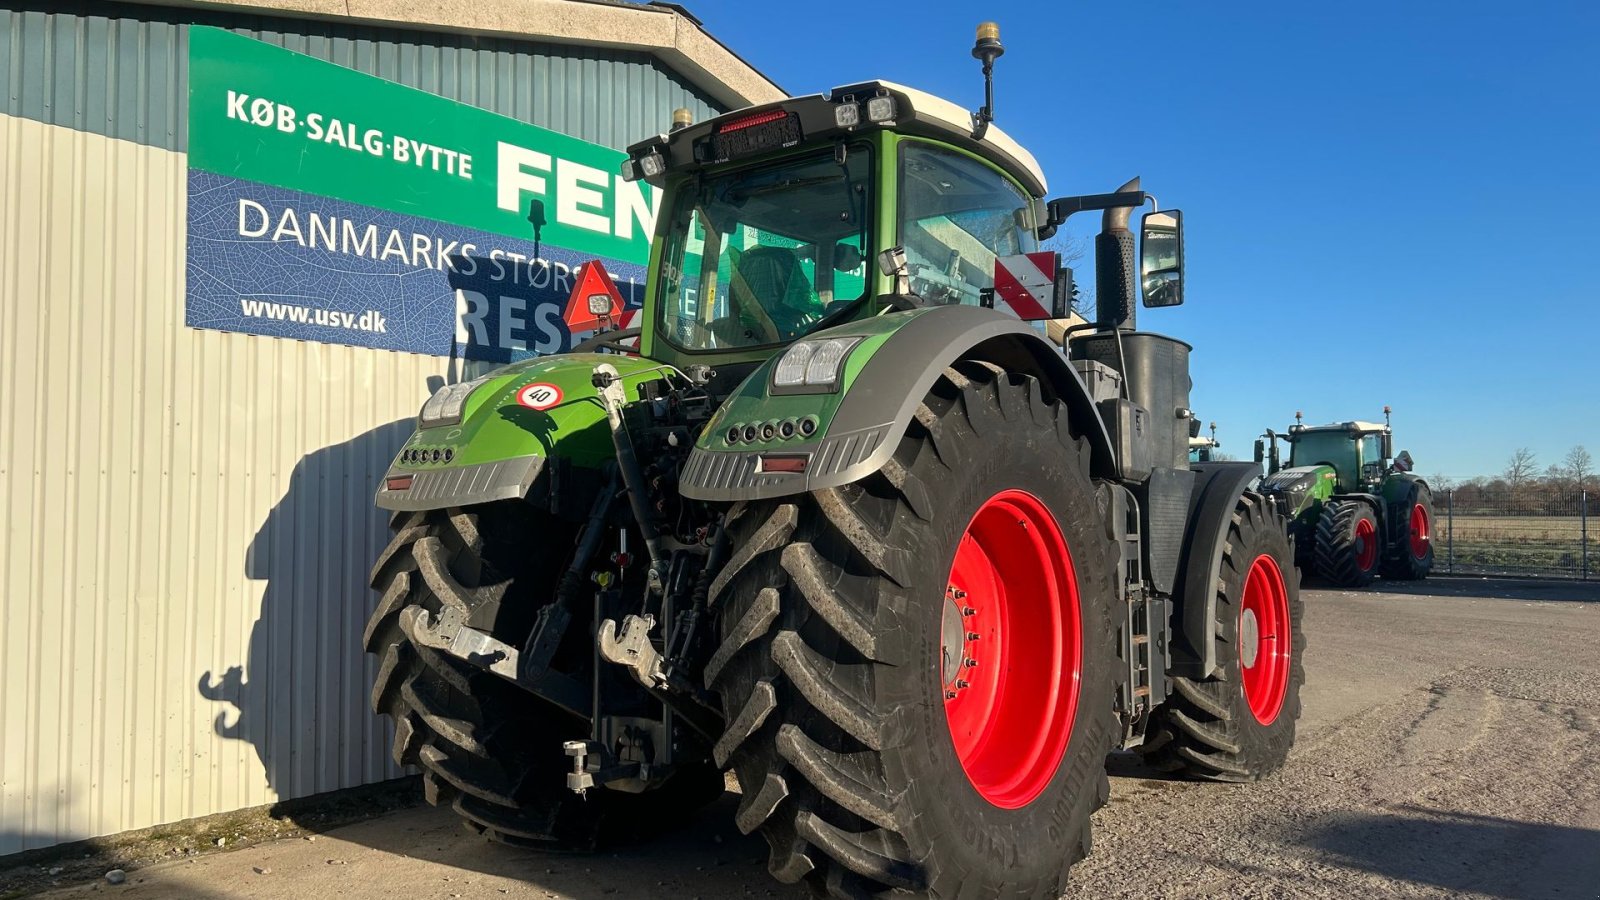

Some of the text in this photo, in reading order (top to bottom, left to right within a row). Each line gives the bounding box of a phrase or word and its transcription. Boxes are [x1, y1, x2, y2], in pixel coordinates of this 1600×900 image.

[239, 198, 477, 276] DANMARKS
[240, 299, 387, 333] www.usv.dk
[528, 387, 552, 403] 40
